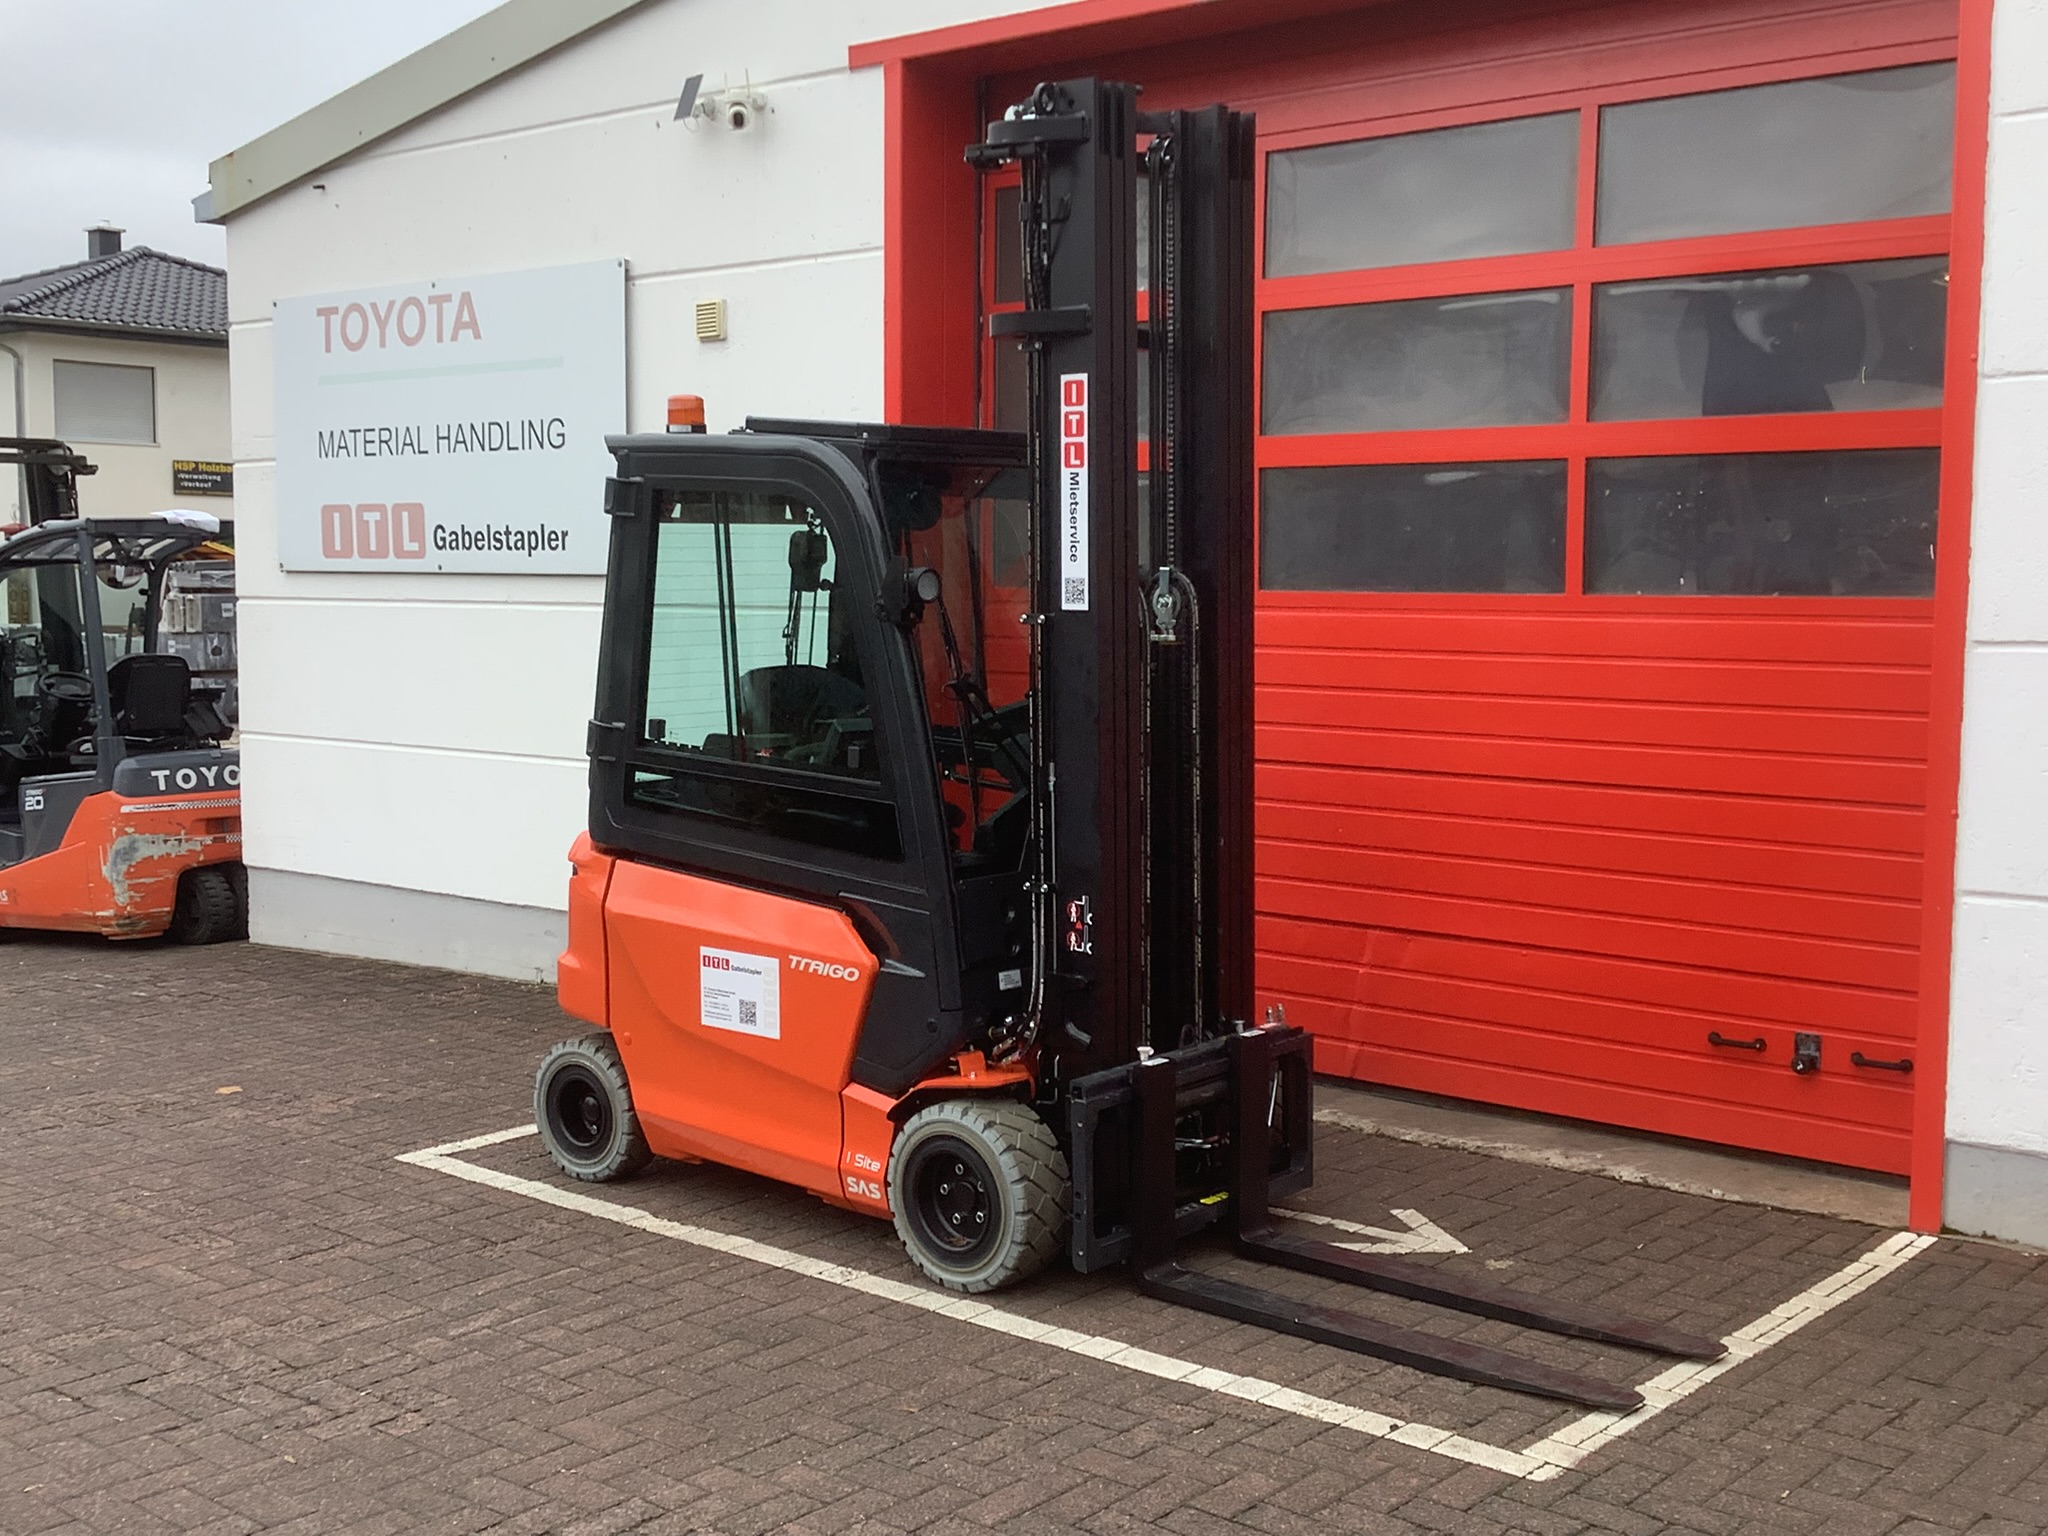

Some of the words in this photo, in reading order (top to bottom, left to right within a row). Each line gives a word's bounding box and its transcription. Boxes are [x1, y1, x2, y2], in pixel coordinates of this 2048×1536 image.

[316, 291, 482, 353] TOYOTA
[318, 426, 429, 459] MATERIAL
[436, 418, 566, 453] HANDLING
[326, 507, 422, 555] ITL
[433, 524, 569, 557] Gabelstapler
[1069, 472, 1080, 563] Mietservice
[25, 796, 44, 811] 20
[703, 956, 729, 970] ITL
[854, 1153, 881, 1172] Site
[847, 1176, 881, 1199] SAS
